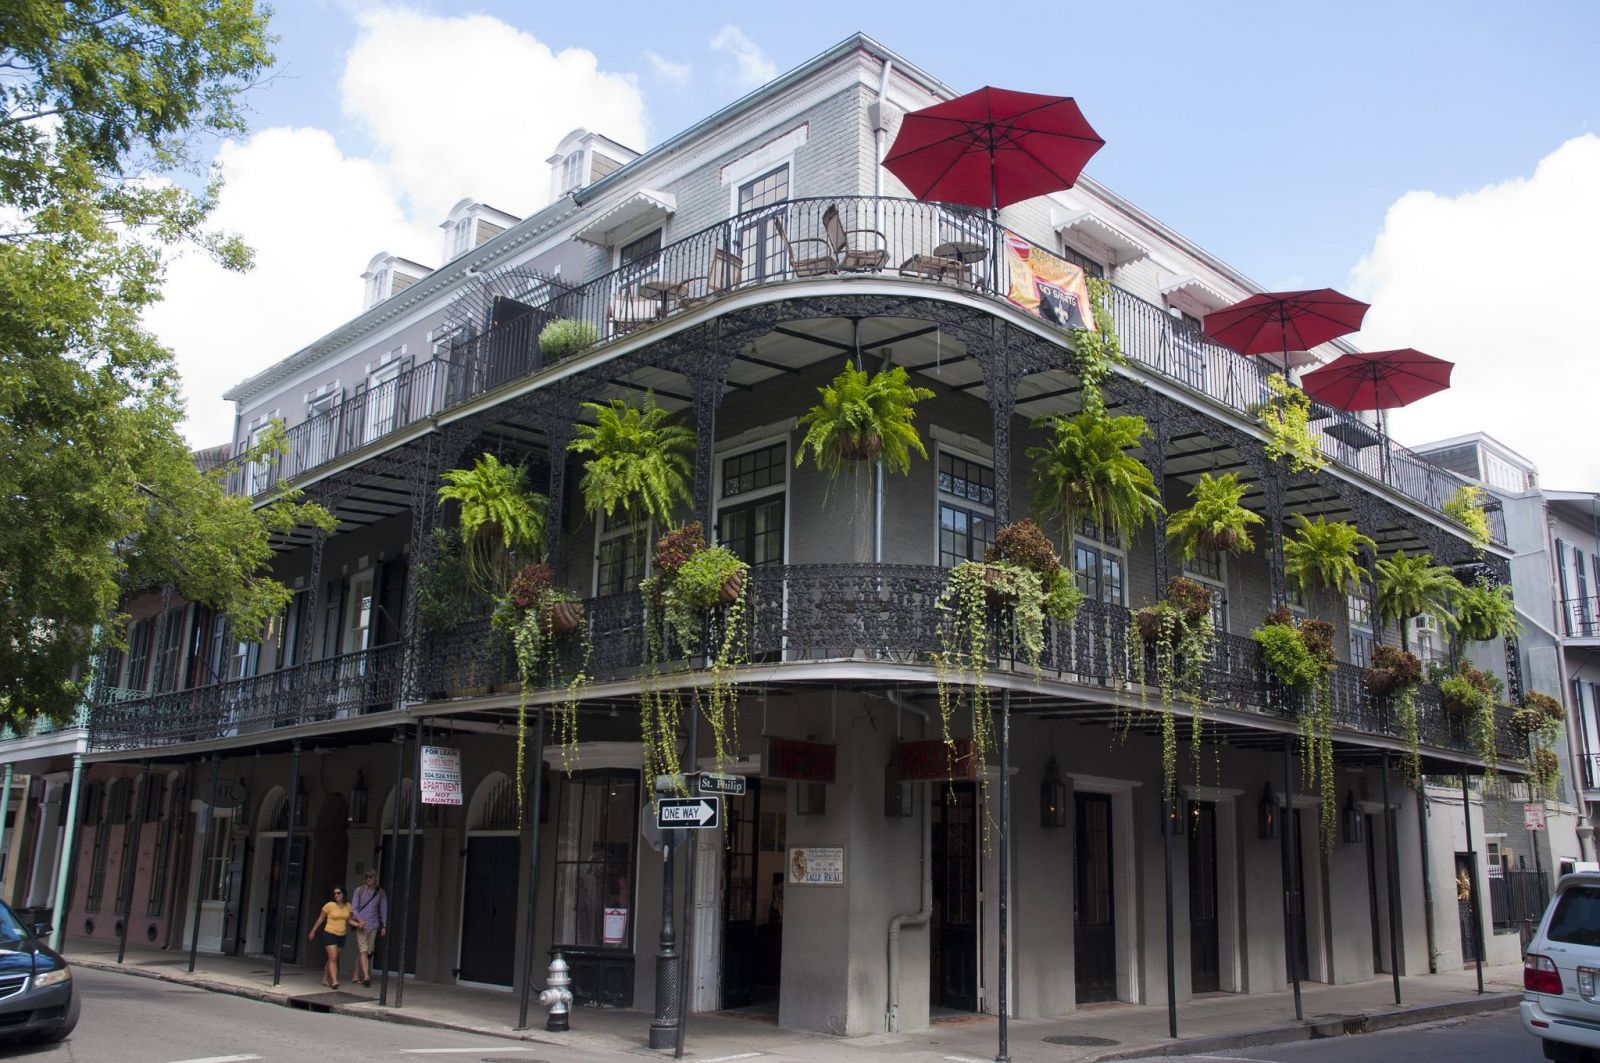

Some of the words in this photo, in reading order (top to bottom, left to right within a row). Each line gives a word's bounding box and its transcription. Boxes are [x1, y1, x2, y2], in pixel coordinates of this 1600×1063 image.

[1039, 283, 1051, 296] GO
[1053, 290, 1076, 307] SAINTS
[423, 781, 460, 792] APARTMENT
[701, 778, 713, 788] St.
[716, 780, 742, 792] Philip
[663, 808, 680, 819] ONE
[682, 807, 700, 818] WAY
[806, 872, 822, 882] CALLE
[824, 872, 842, 882] REAL
